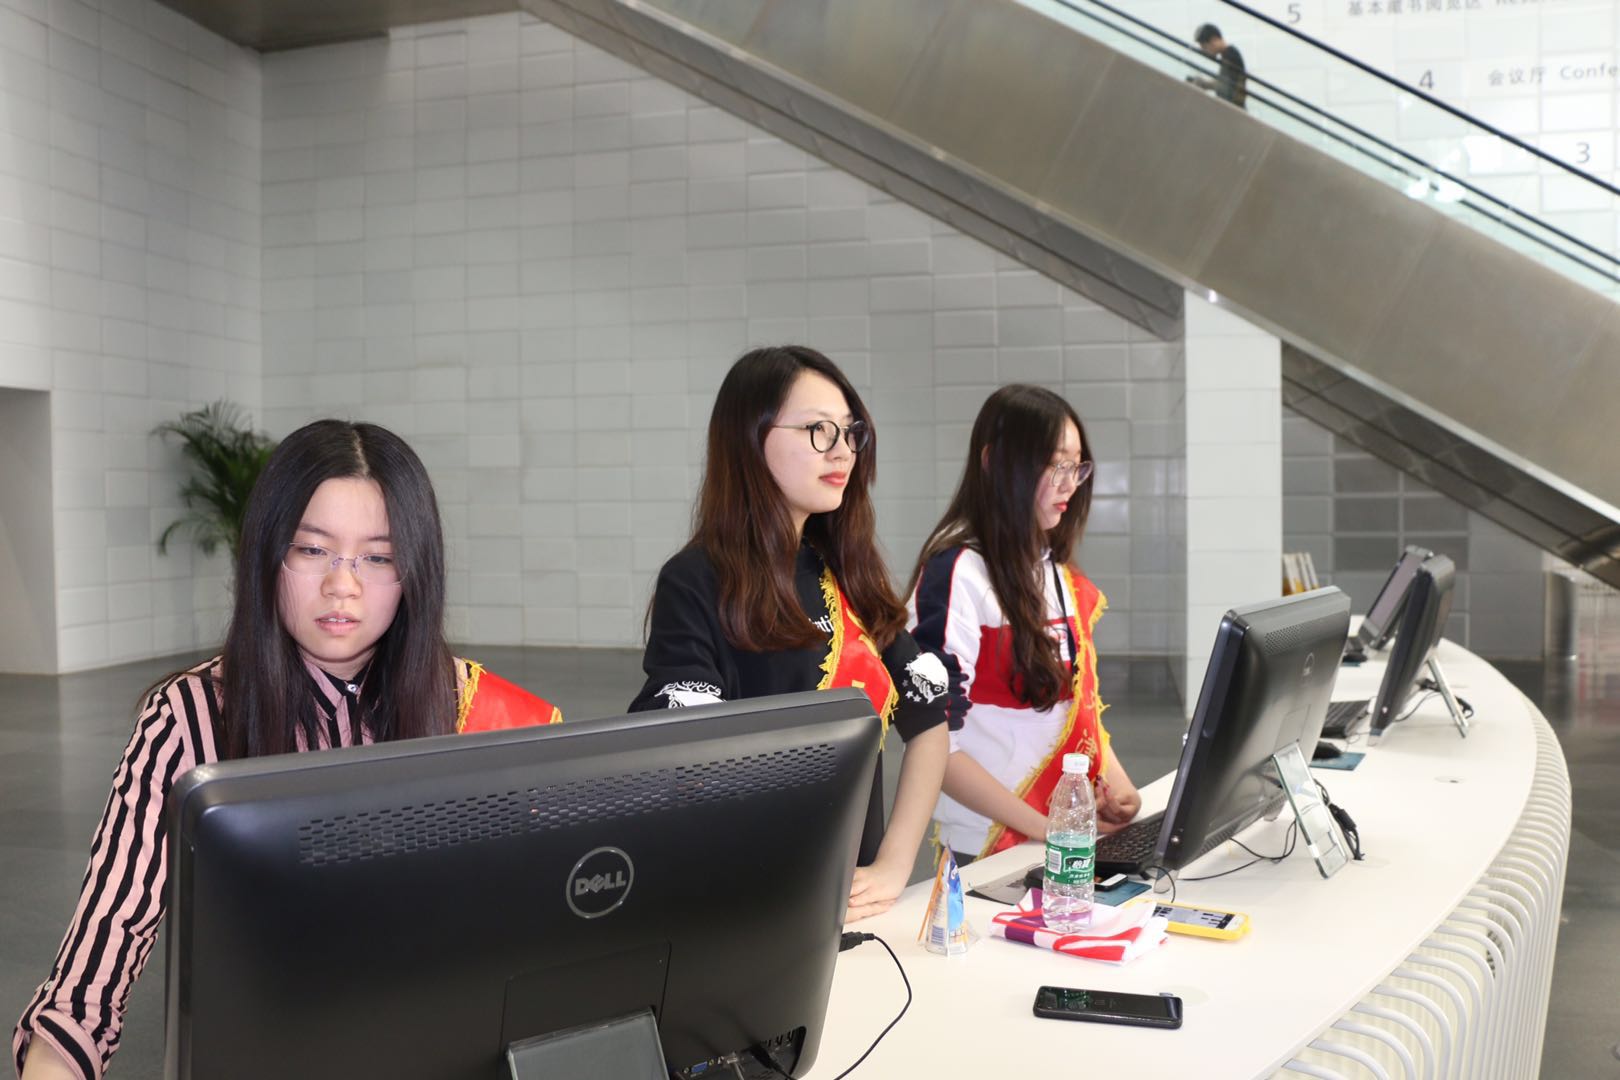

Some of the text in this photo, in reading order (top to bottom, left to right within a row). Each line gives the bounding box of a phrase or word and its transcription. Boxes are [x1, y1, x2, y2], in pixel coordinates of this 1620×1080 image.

[1287, 3, 1301, 24] 5
[1419, 69, 1434, 90] 4
[1489, 66, 1546, 86] 会议厅
[1576, 142, 1591, 164] 3
[575, 870, 626, 896] DELL
